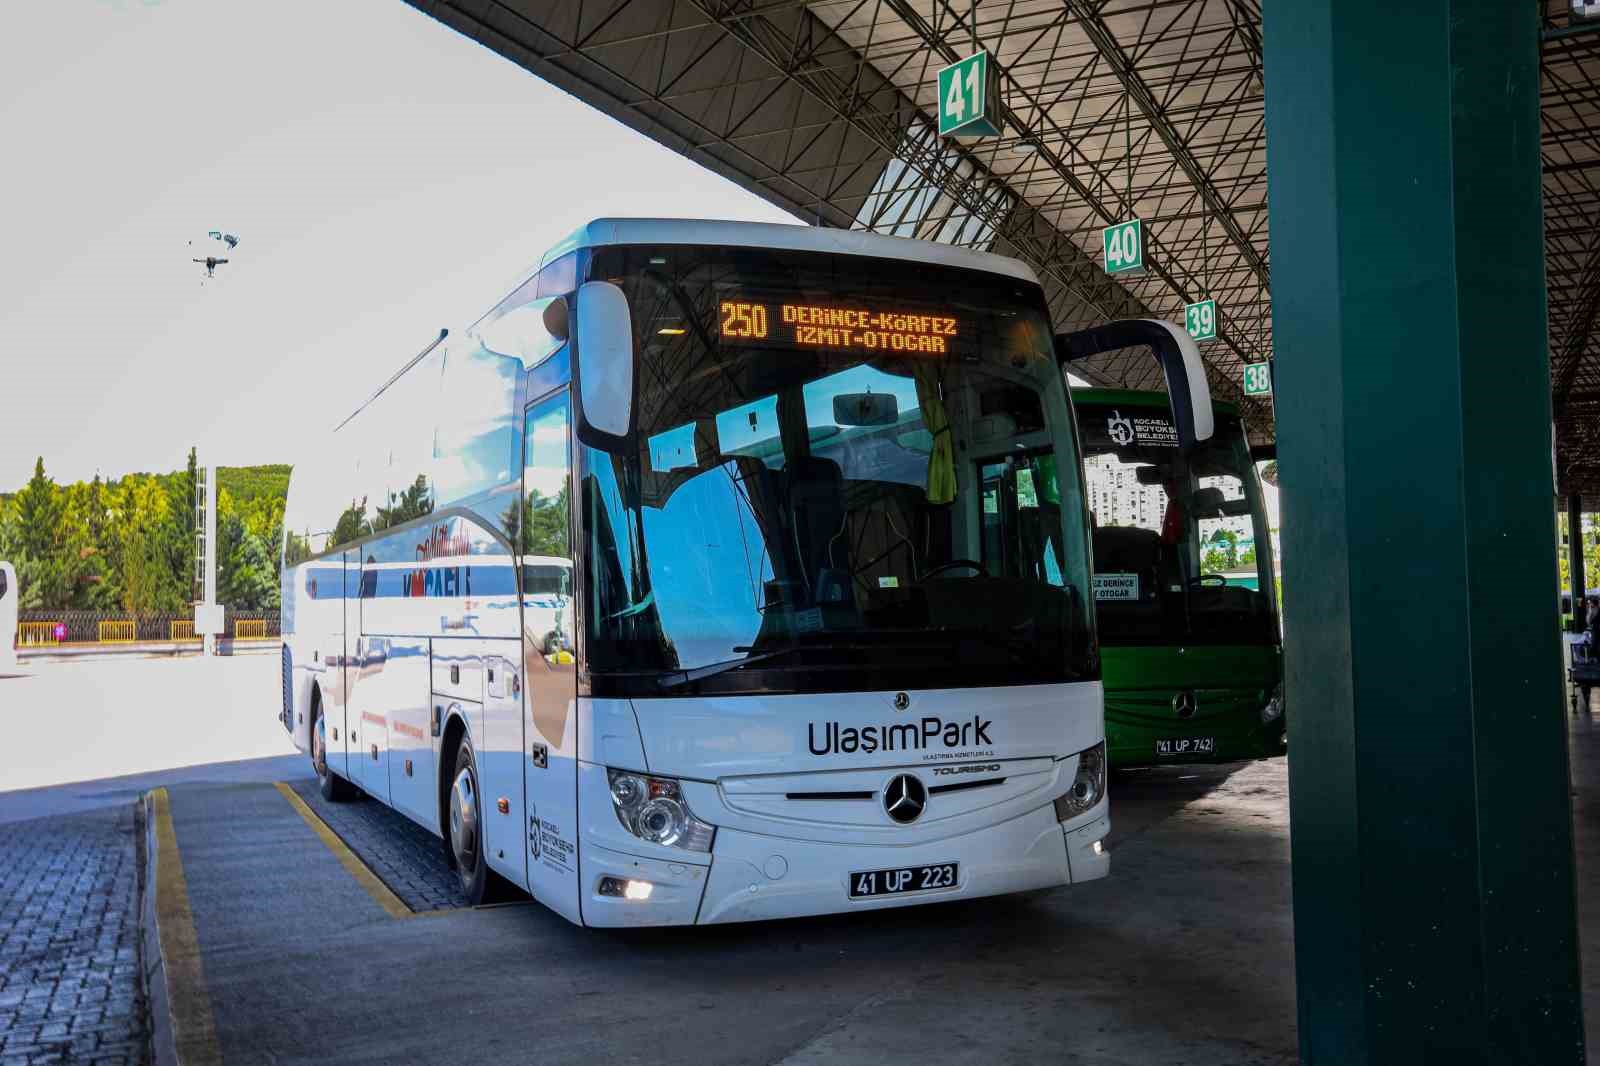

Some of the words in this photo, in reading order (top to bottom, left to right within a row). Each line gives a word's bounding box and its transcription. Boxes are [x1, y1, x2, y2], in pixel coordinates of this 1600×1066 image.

[945, 60, 980, 121] 41
[1107, 226, 1137, 265] 40
[720, 303, 768, 338] 250
[1188, 304, 1213, 337] 39
[1247, 366, 1268, 391] 38
[808, 714, 993, 755] UlaşımPark
[1161, 740, 1171, 752] 41
[1175, 739, 1190, 752] UP
[1193, 738, 1211, 751] 742
[932, 764, 1001, 776] TOURISMO
[856, 873, 876, 894] 41
[885, 870, 912, 892] UP
[920, 865, 954, 888] 223
